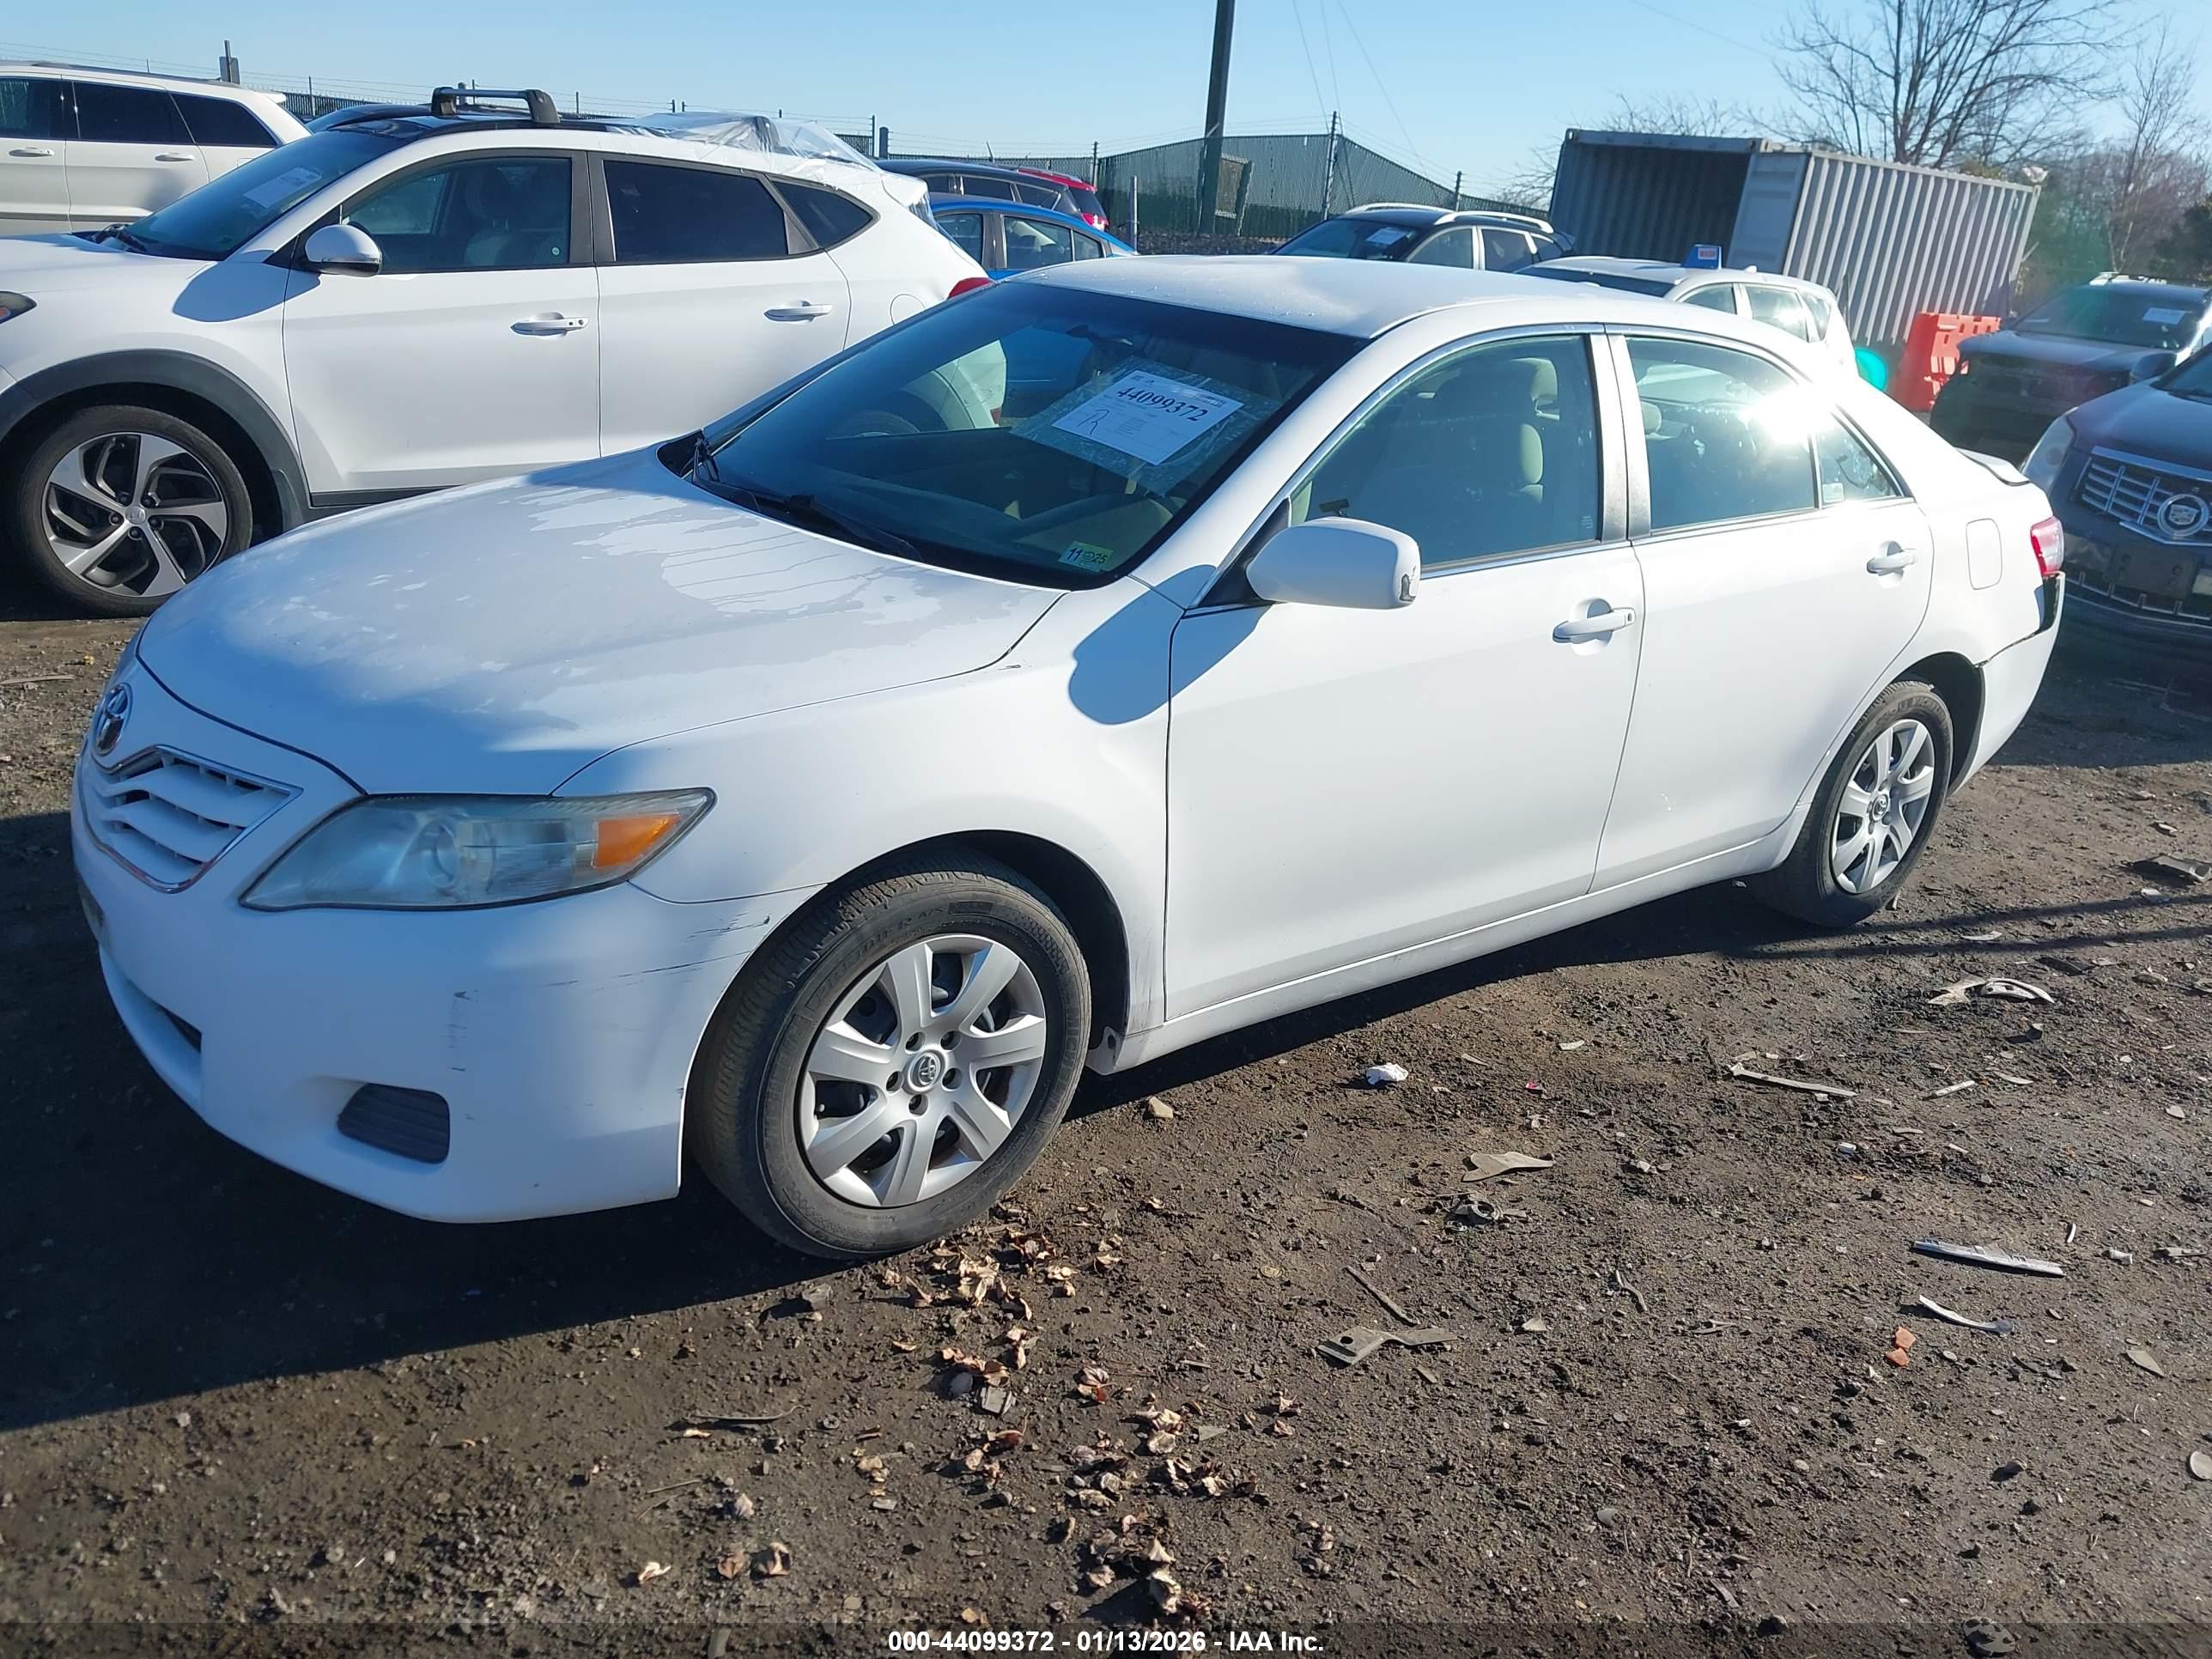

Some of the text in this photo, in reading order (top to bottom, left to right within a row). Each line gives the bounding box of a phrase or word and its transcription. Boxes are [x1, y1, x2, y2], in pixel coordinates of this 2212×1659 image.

[1117, 386, 1208, 422] 44099372
[1066, 547, 1108, 564] 11 25
